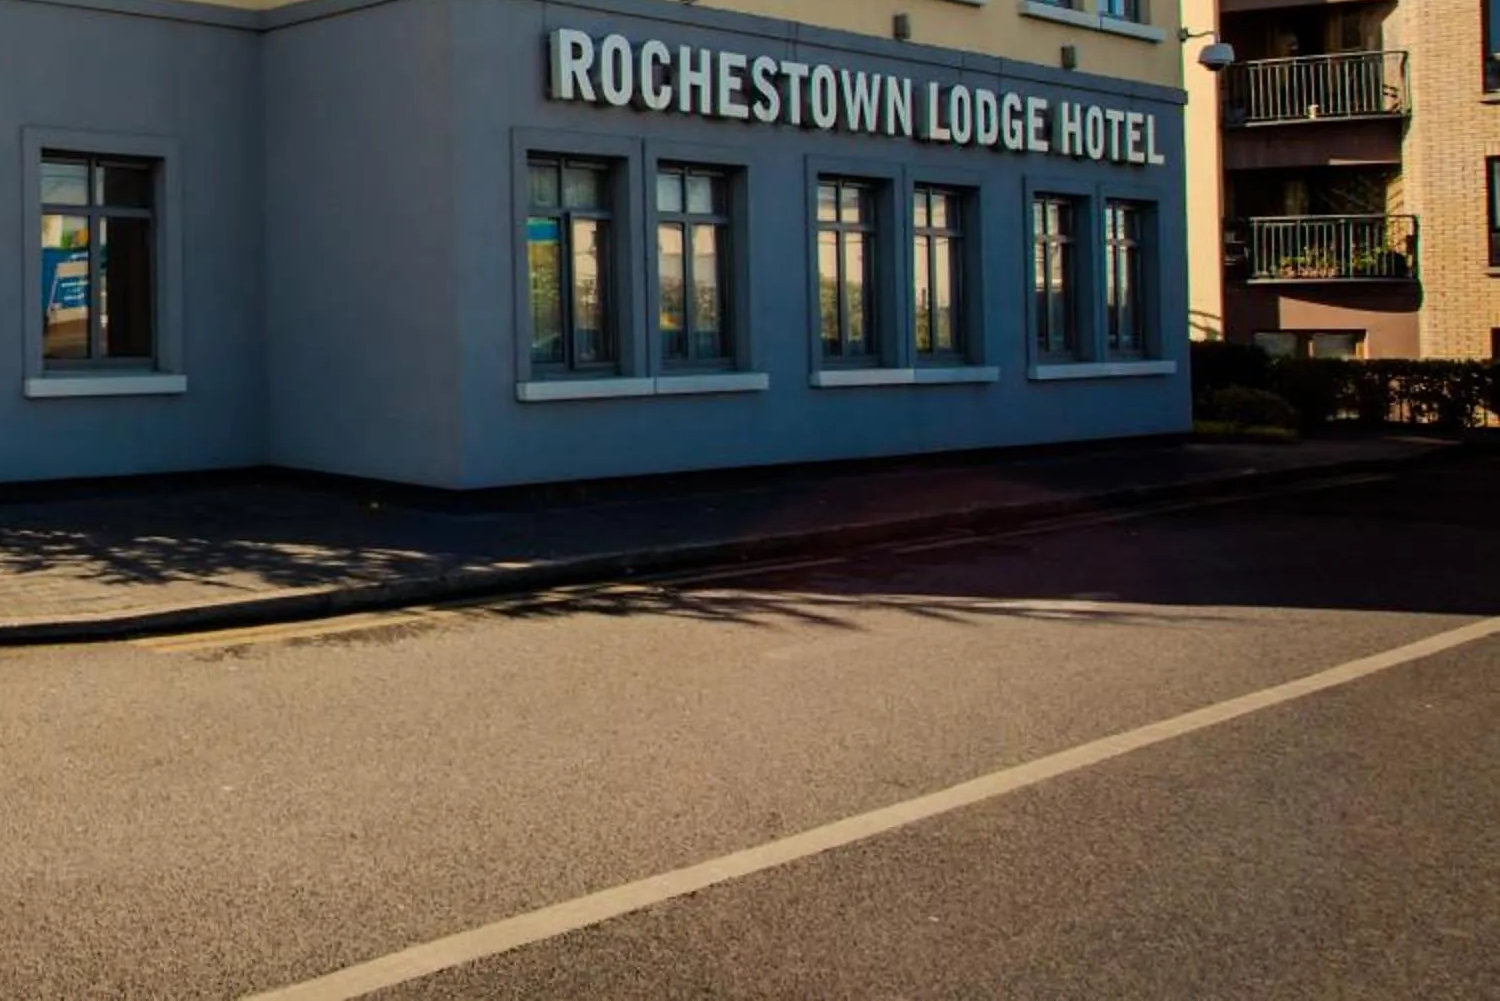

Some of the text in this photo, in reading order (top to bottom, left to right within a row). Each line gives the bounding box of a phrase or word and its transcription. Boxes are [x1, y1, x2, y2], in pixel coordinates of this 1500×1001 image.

[553, 28, 1165, 165] ROCHESTOWN LODGE HOTEL
